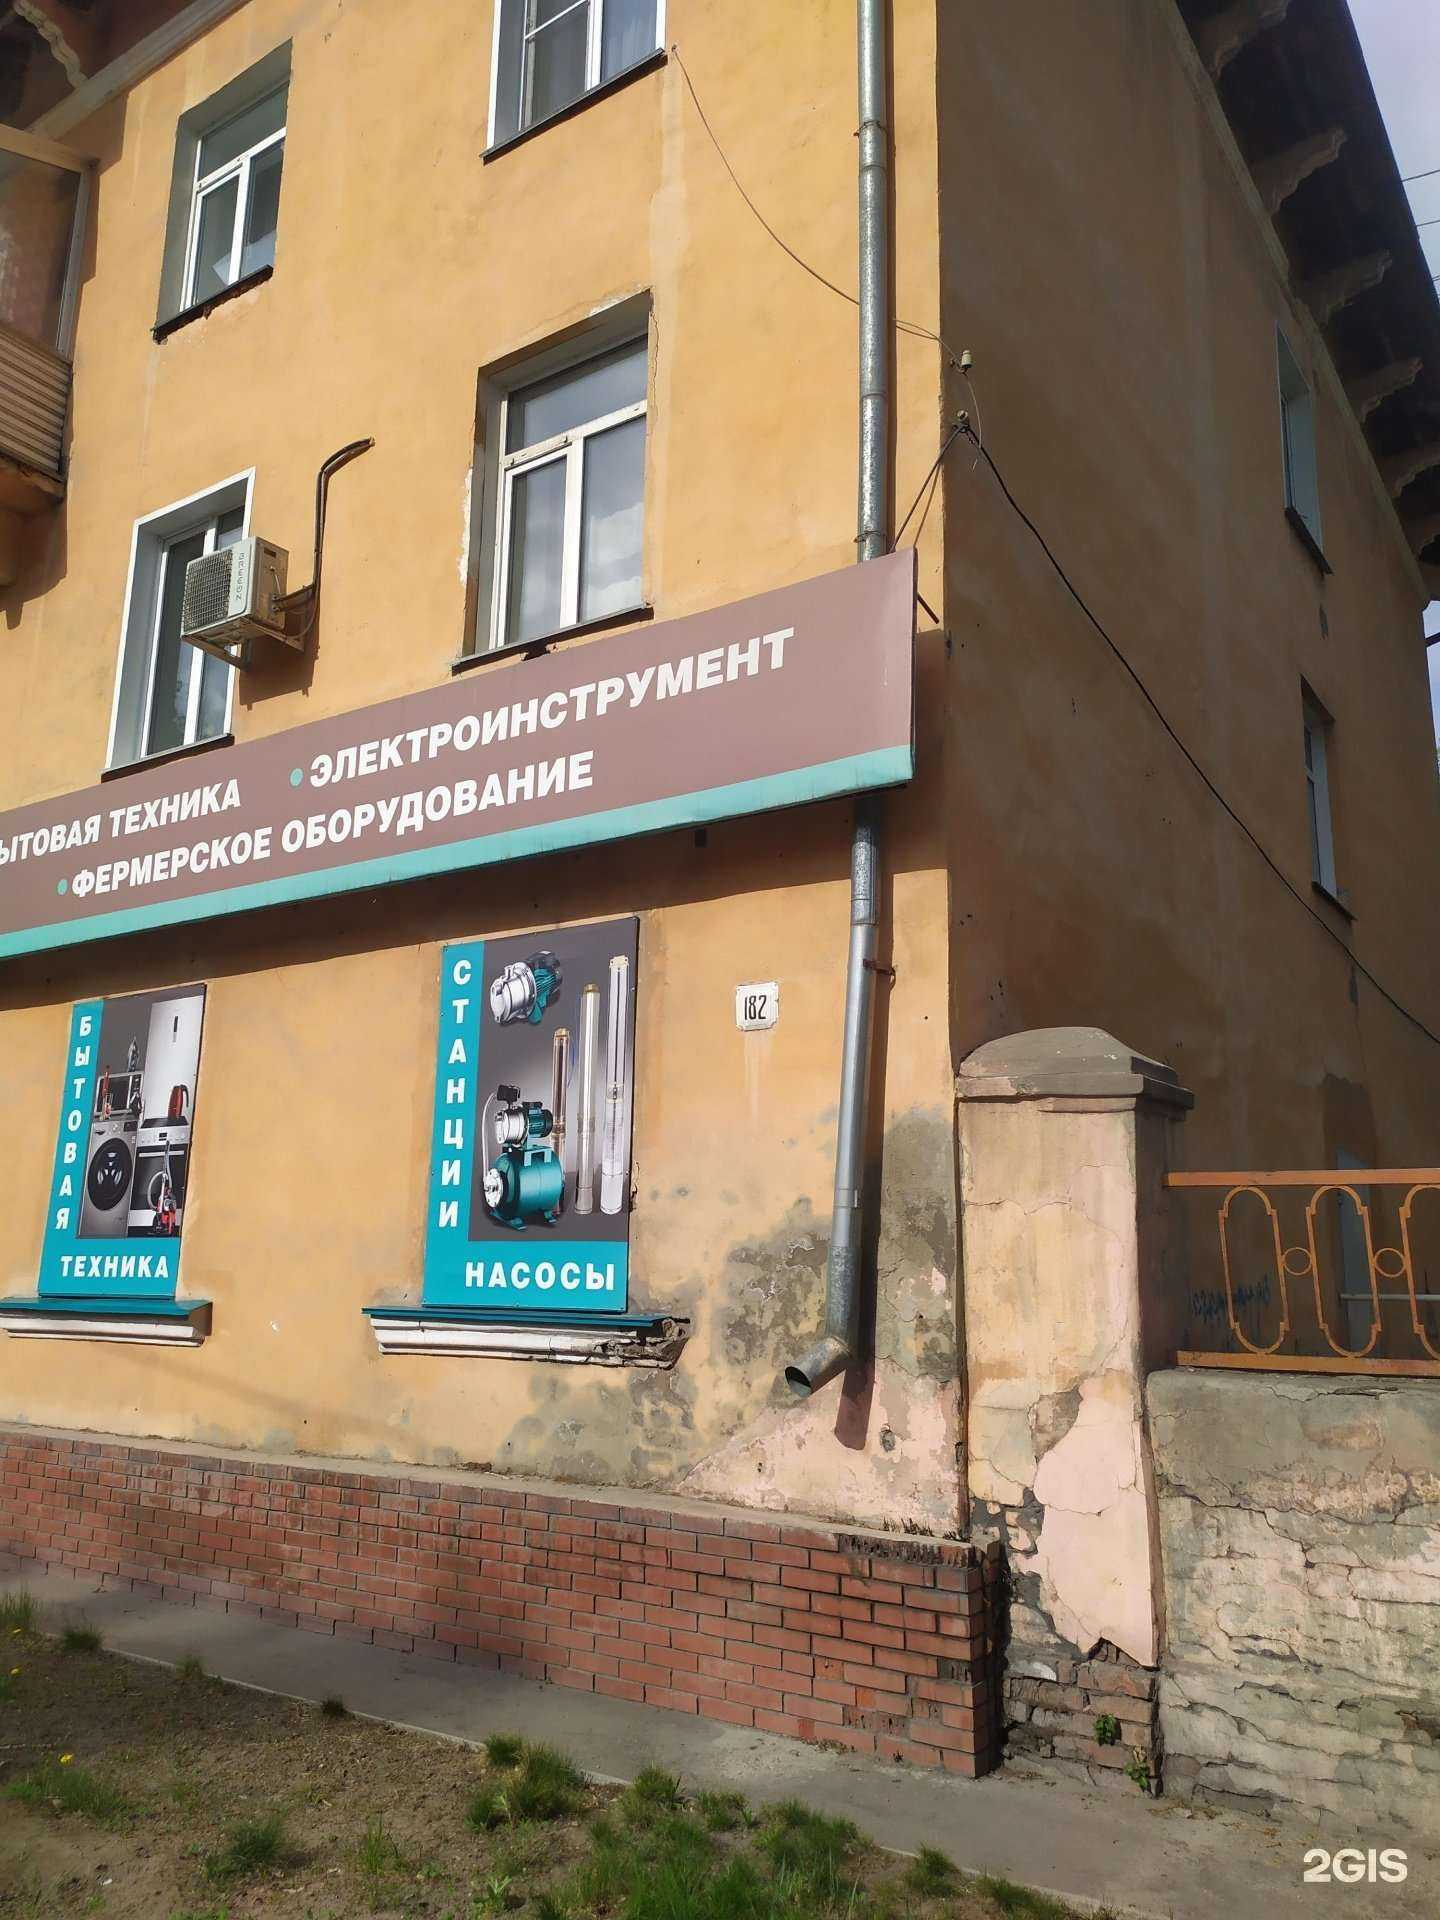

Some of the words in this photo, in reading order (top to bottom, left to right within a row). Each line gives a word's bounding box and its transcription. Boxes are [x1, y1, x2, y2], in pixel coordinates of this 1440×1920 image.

[110, 779, 240, 837] ТЕХНИКА
[310, 627, 794, 787] ЭЛЕКТРОИНСТРУМЕНТ
[72, 827, 272, 897] ФЕРМЕРСКОЕ
[282, 751, 593, 852] ОБОРУДОВАНИЕ
[744, 994, 767, 1020] 182
[57, 1016, 90, 1228] БЫТОВАЯ
[439, 960, 470, 1226] СТАНЦИИ
[62, 1256, 167, 1277] ТЕХНИКА
[466, 1263, 613, 1289] НАСОСЫ
